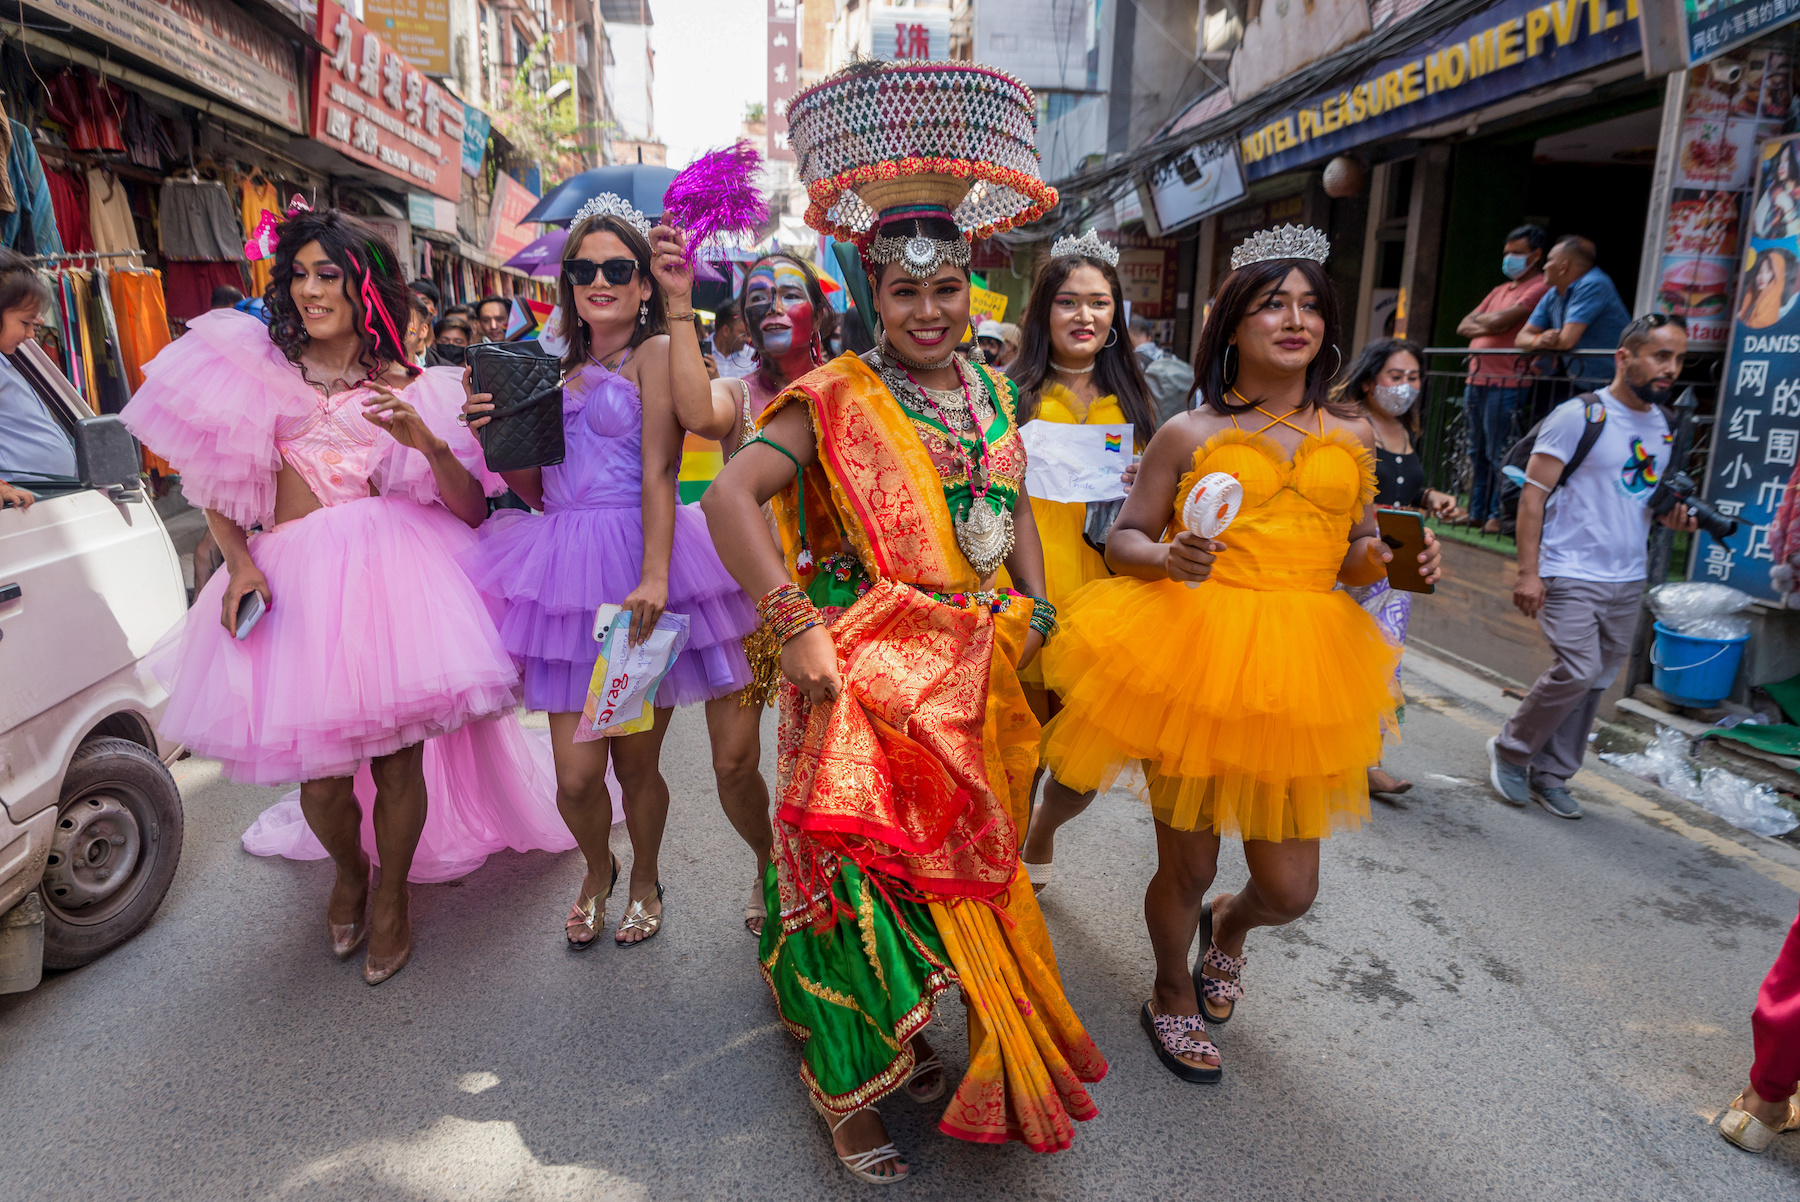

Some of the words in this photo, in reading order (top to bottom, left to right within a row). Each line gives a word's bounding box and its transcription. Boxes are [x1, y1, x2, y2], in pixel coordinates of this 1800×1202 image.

[1241, 116, 1299, 165] HOTEL
[1299, 62, 1422, 140] PLEASURE
[1425, 18, 1520, 96] HOME
[1068, 471, 1096, 490] Pride
[598, 673, 629, 726] Drag
